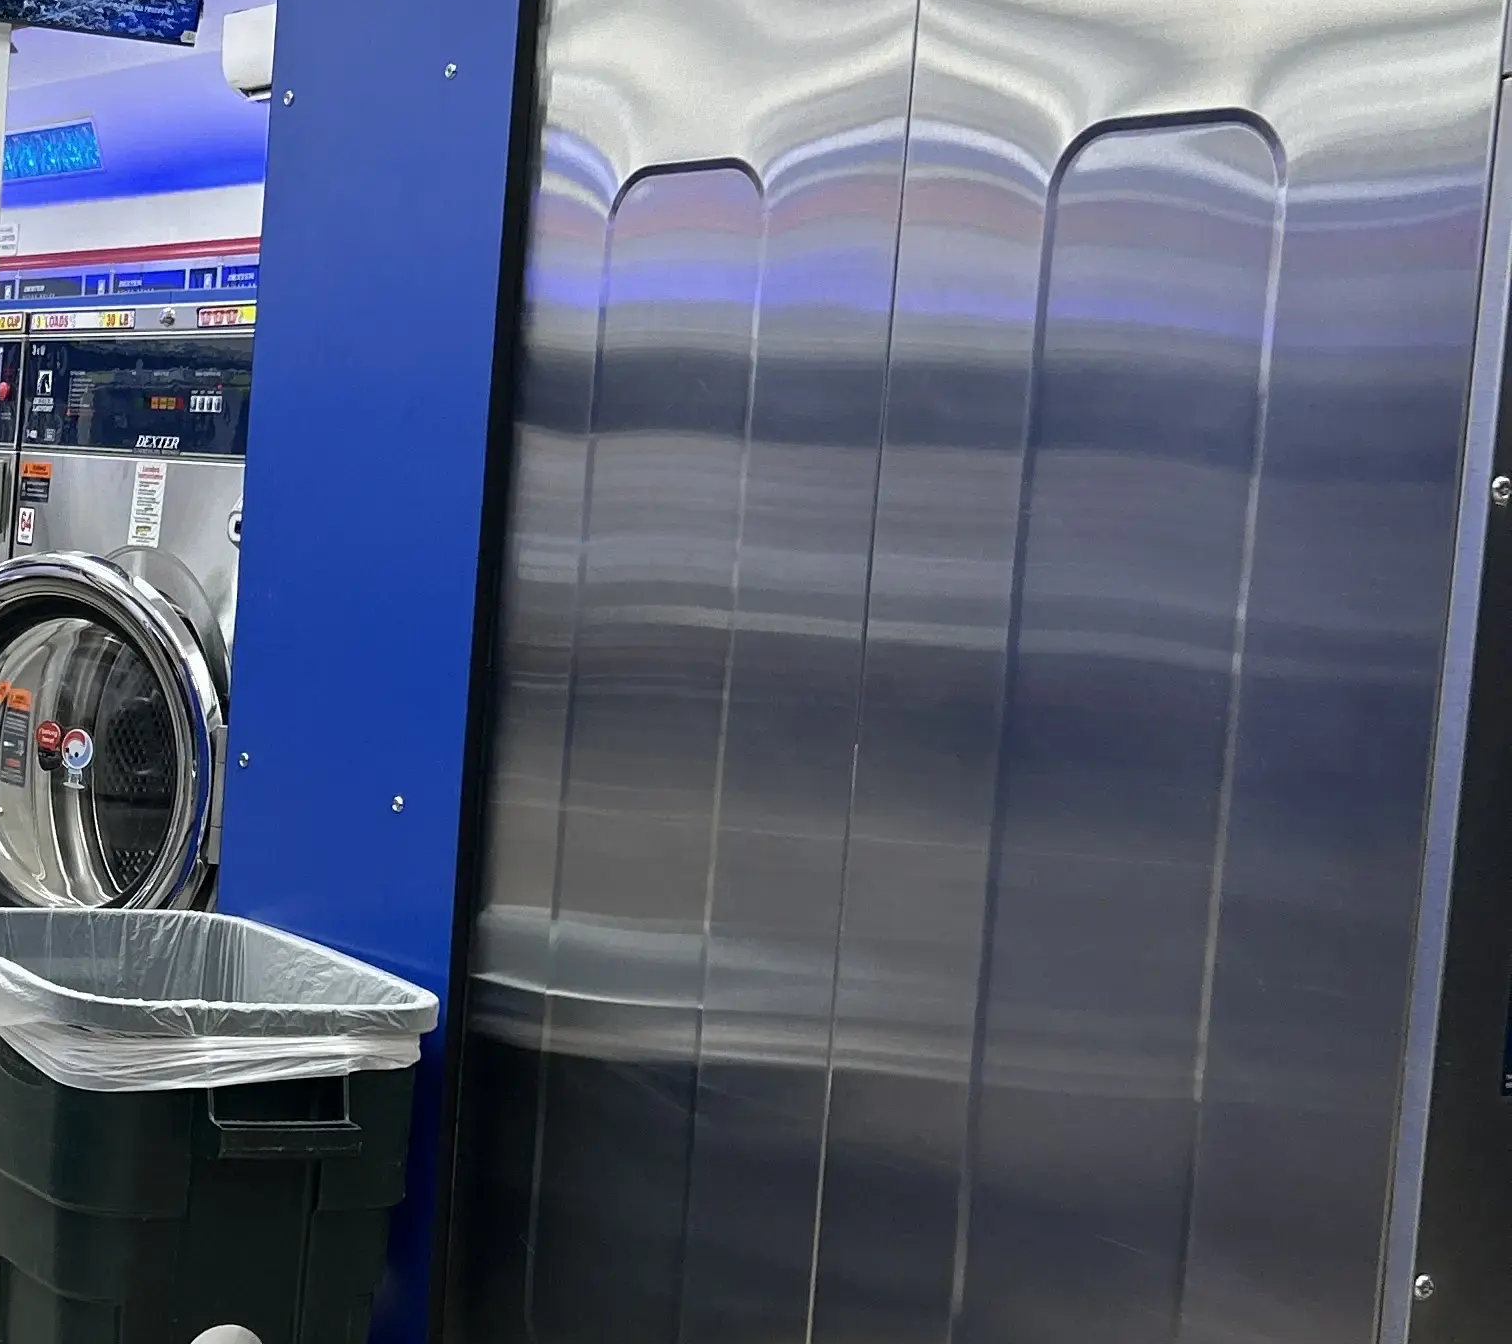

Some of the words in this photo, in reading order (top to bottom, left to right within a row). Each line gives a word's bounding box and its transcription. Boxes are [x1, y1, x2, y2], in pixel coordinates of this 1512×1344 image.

[44, 314, 69, 328] LOADS
[119, 313, 129, 326] LB
[135, 434, 181, 450] DEXTER
